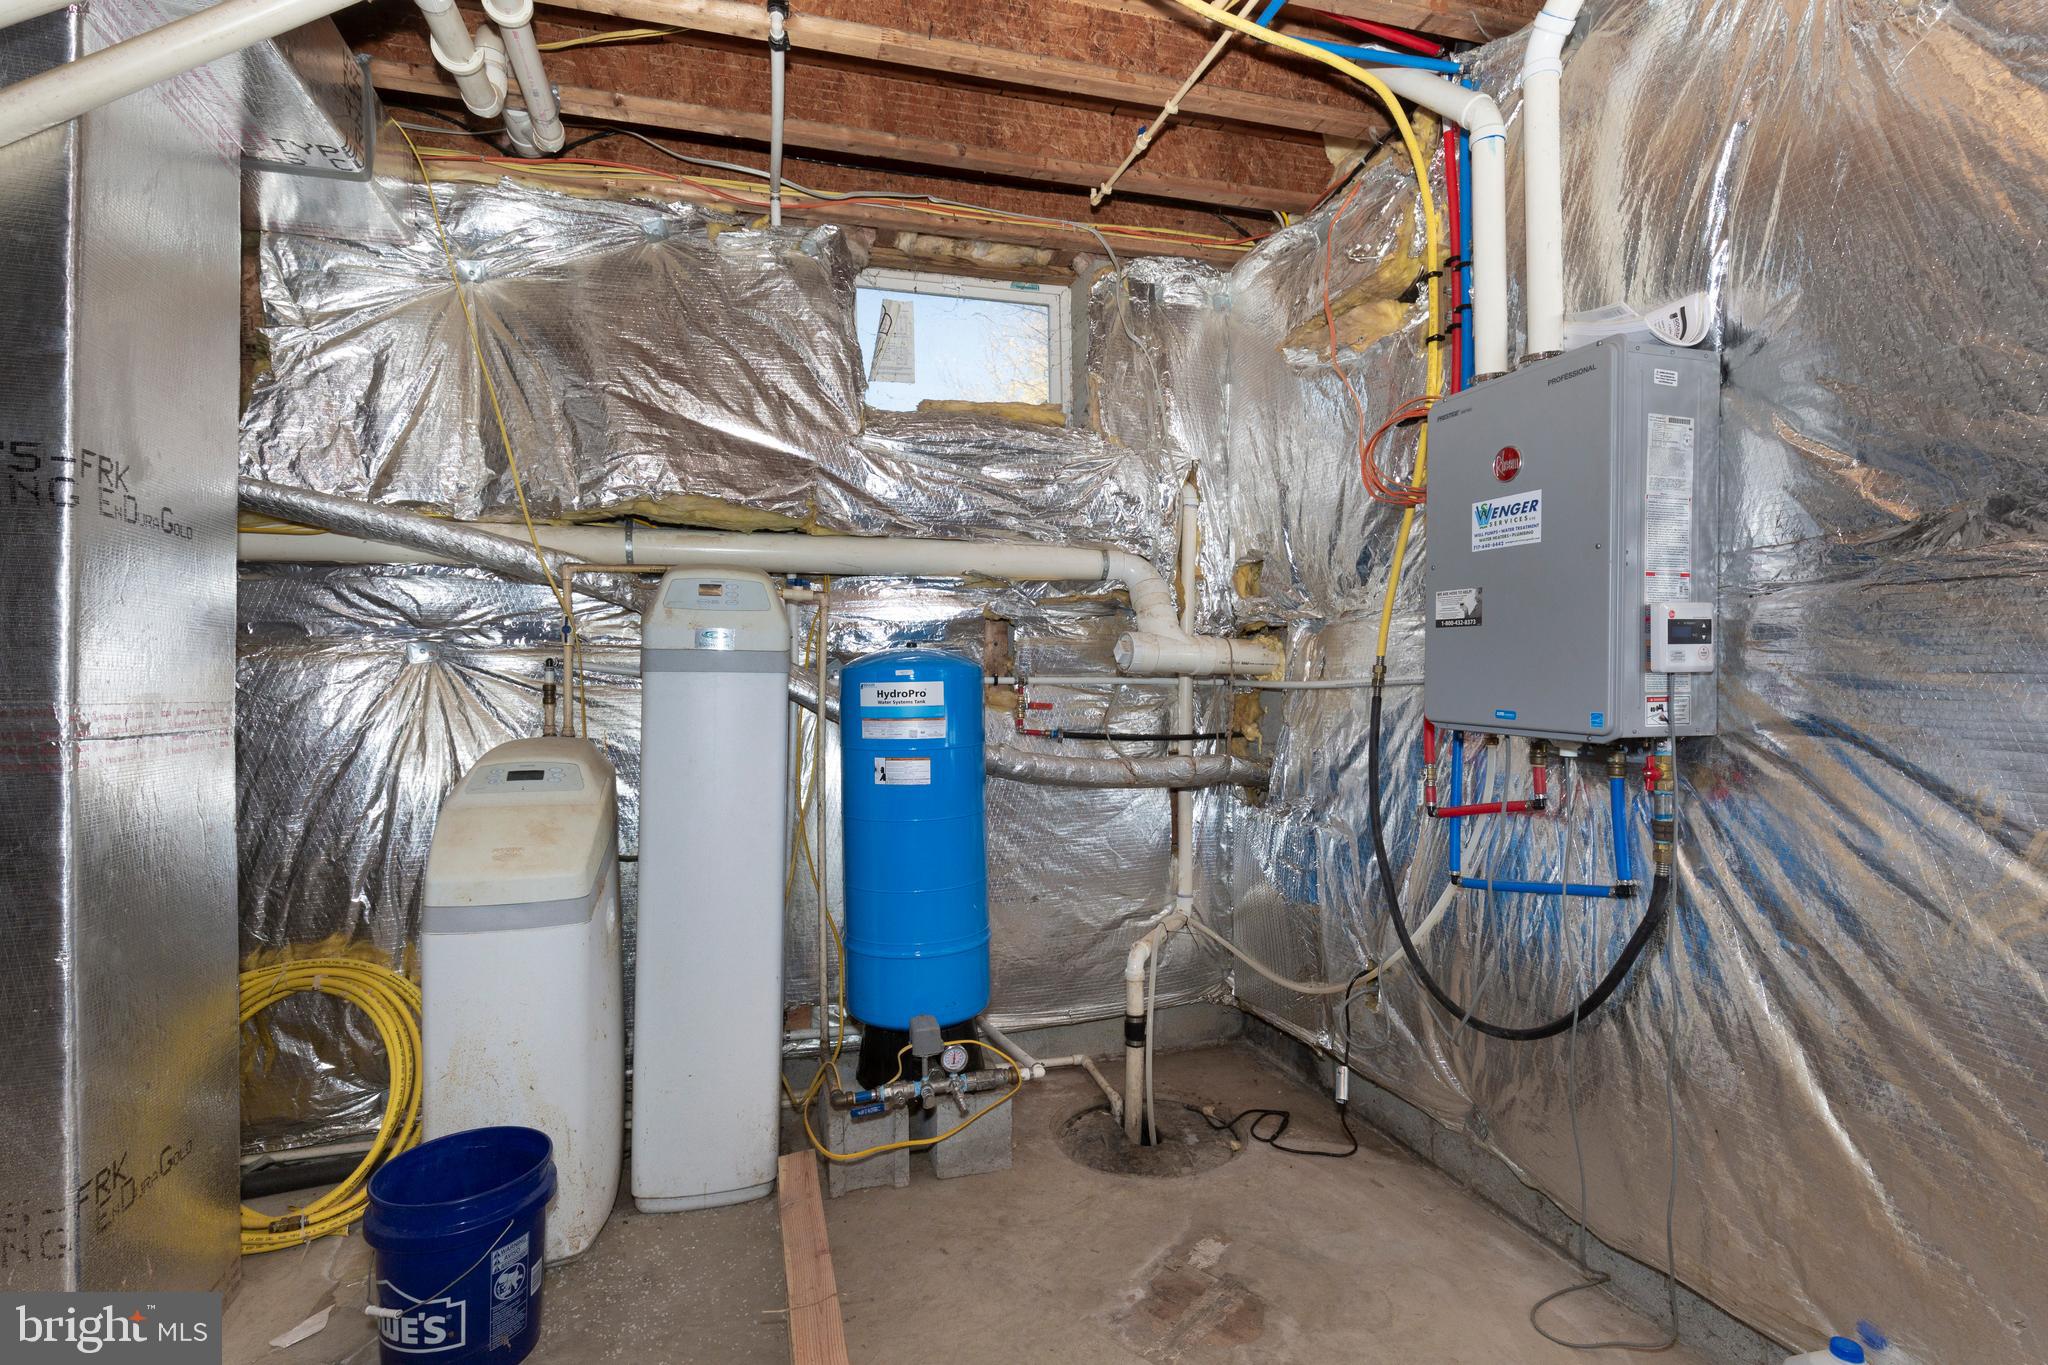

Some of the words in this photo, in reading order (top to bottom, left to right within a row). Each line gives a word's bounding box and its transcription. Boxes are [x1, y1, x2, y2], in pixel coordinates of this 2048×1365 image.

[1547, 364, 1598, 387] PROFESSIONAL
[1475, 500, 1539, 525] WENGER
[1489, 515, 1529, 528] SERVICES
[877, 689, 927, 700] HydroPro
[378, 1312, 447, 1345] WE'S
